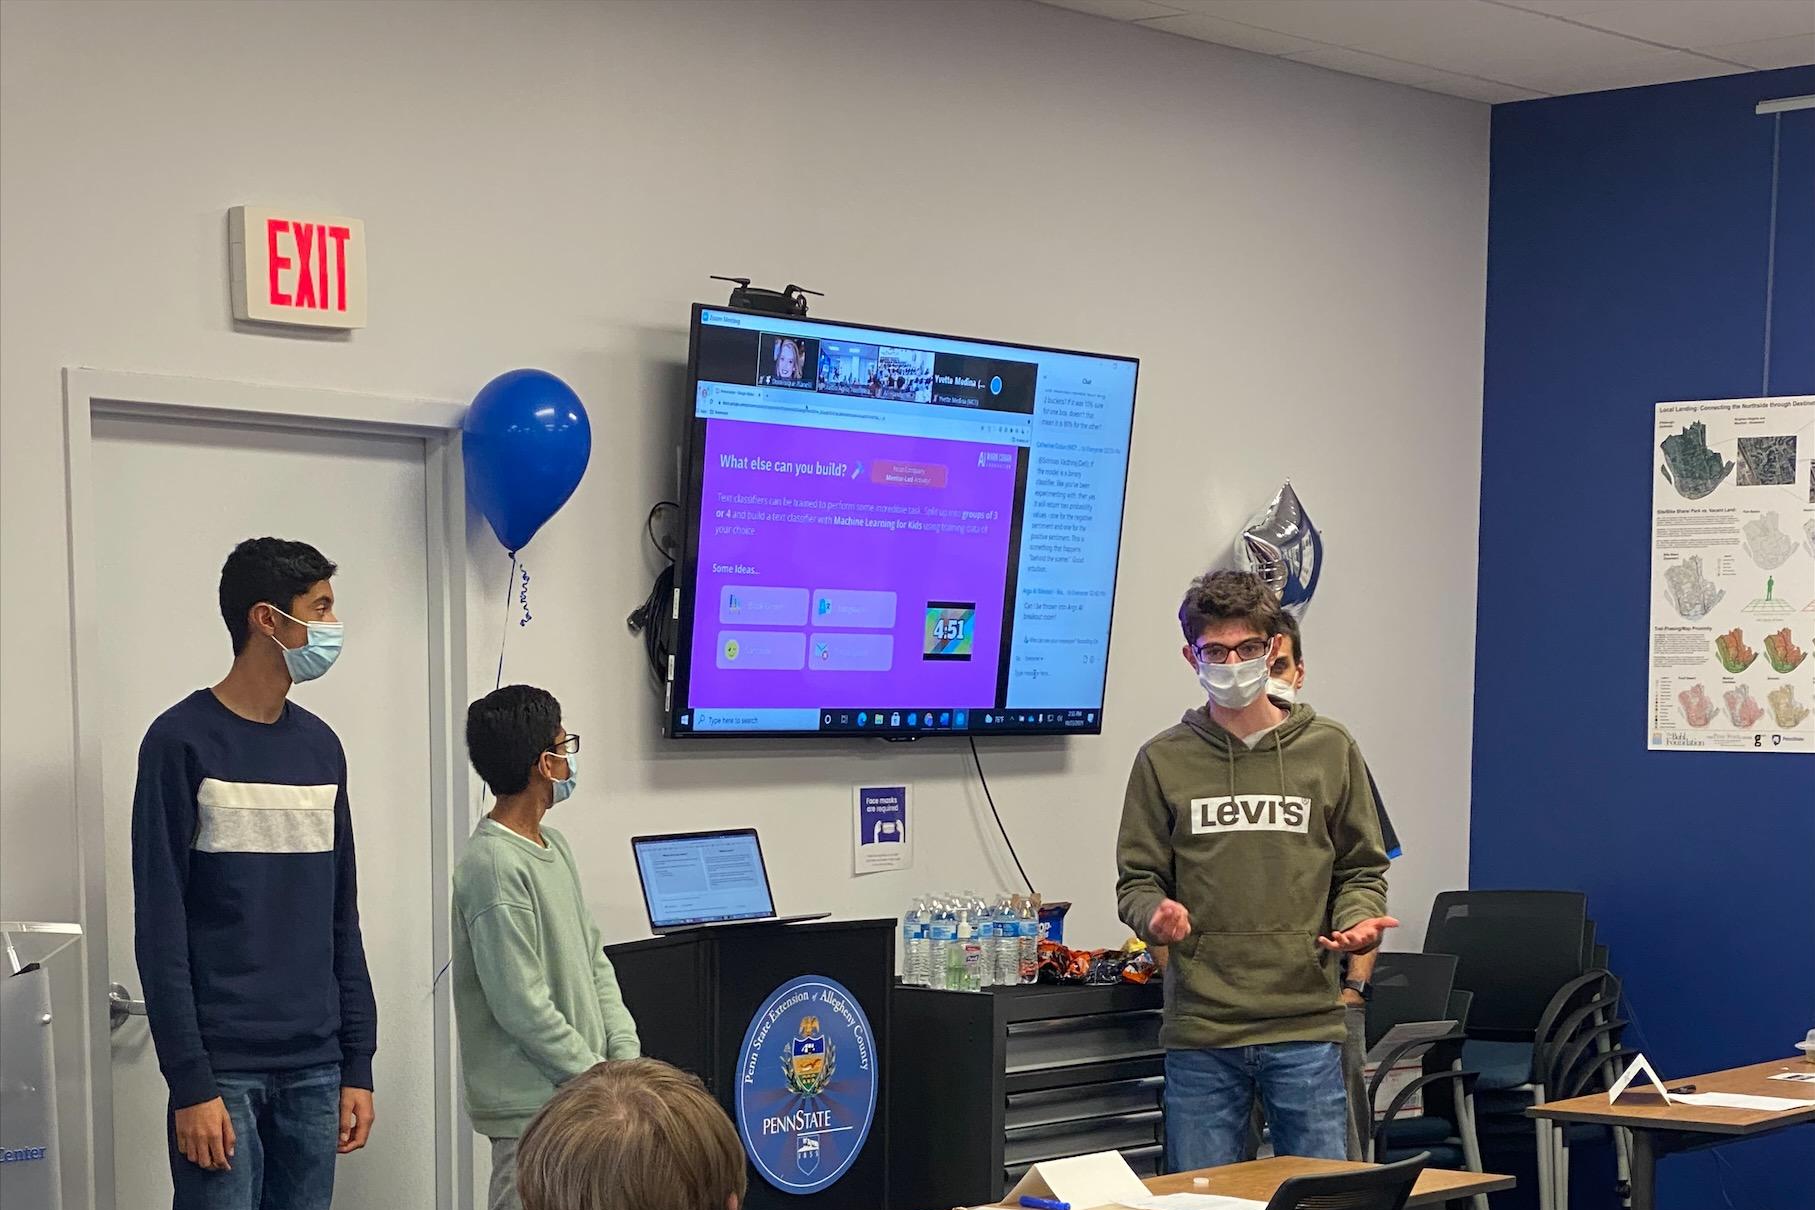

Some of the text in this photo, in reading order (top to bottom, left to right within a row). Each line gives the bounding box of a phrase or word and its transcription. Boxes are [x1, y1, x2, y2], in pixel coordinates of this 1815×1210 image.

[267, 218, 350, 312] EXIT
[935, 375, 953, 385] Yvette
[955, 377, 976, 387] Medina
[1700, 403, 1731, 411] Connecting
[720, 454, 847, 477] What else can you build?
[715, 510, 724, 518] or
[724, 509, 732, 518] 4
[834, 515, 864, 527] Machine
[865, 517, 895, 530] Learning
[896, 519, 907, 528] for
[908, 519, 923, 530] Kids
[962, 511, 985, 520] groups
[985, 510, 993, 519] of
[993, 511, 999, 520] 3
[712, 564, 760, 575] Some Ideas...
[933, 619, 965, 640] 4:51
[709, 717, 759, 726] Type here to search
[880, 796, 898, 804] masks
[876, 804, 899, 813] required
[744, 1052, 759, 1084] Penn
[753, 1021, 772, 1051] State
[770, 990, 809, 1022] Extension
[820, 989, 855, 1028] Allegheny
[853, 1024, 869, 1071] County
